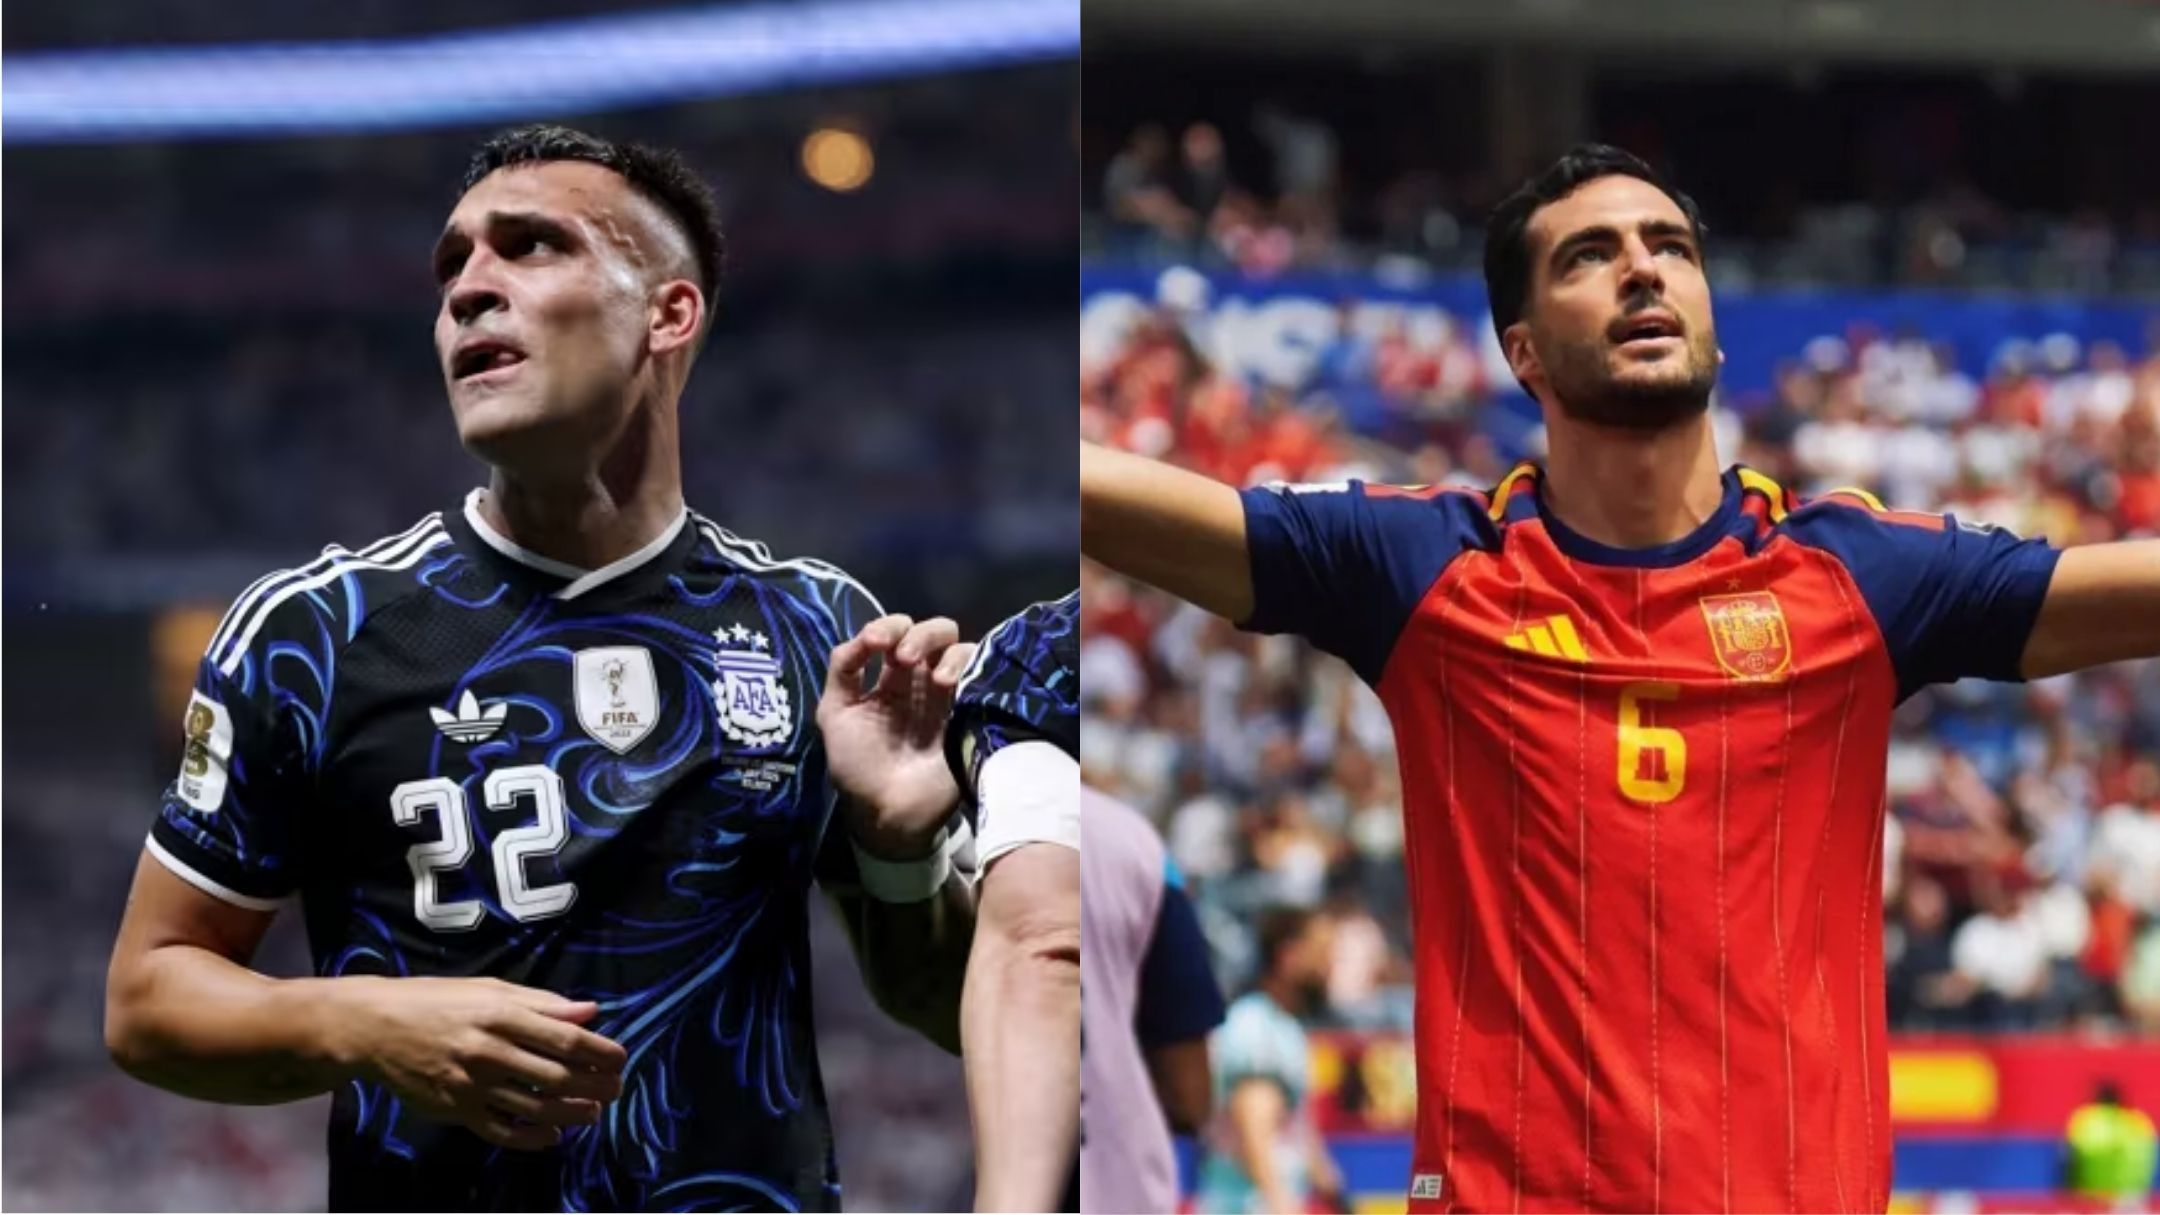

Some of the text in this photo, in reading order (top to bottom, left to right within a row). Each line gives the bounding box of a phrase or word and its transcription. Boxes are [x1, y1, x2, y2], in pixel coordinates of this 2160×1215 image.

[602, 711, 638, 726] FIFA
[733, 674, 776, 719] AFA
[1617, 682, 1687, 802] 6
[390, 764, 578, 932] 22
